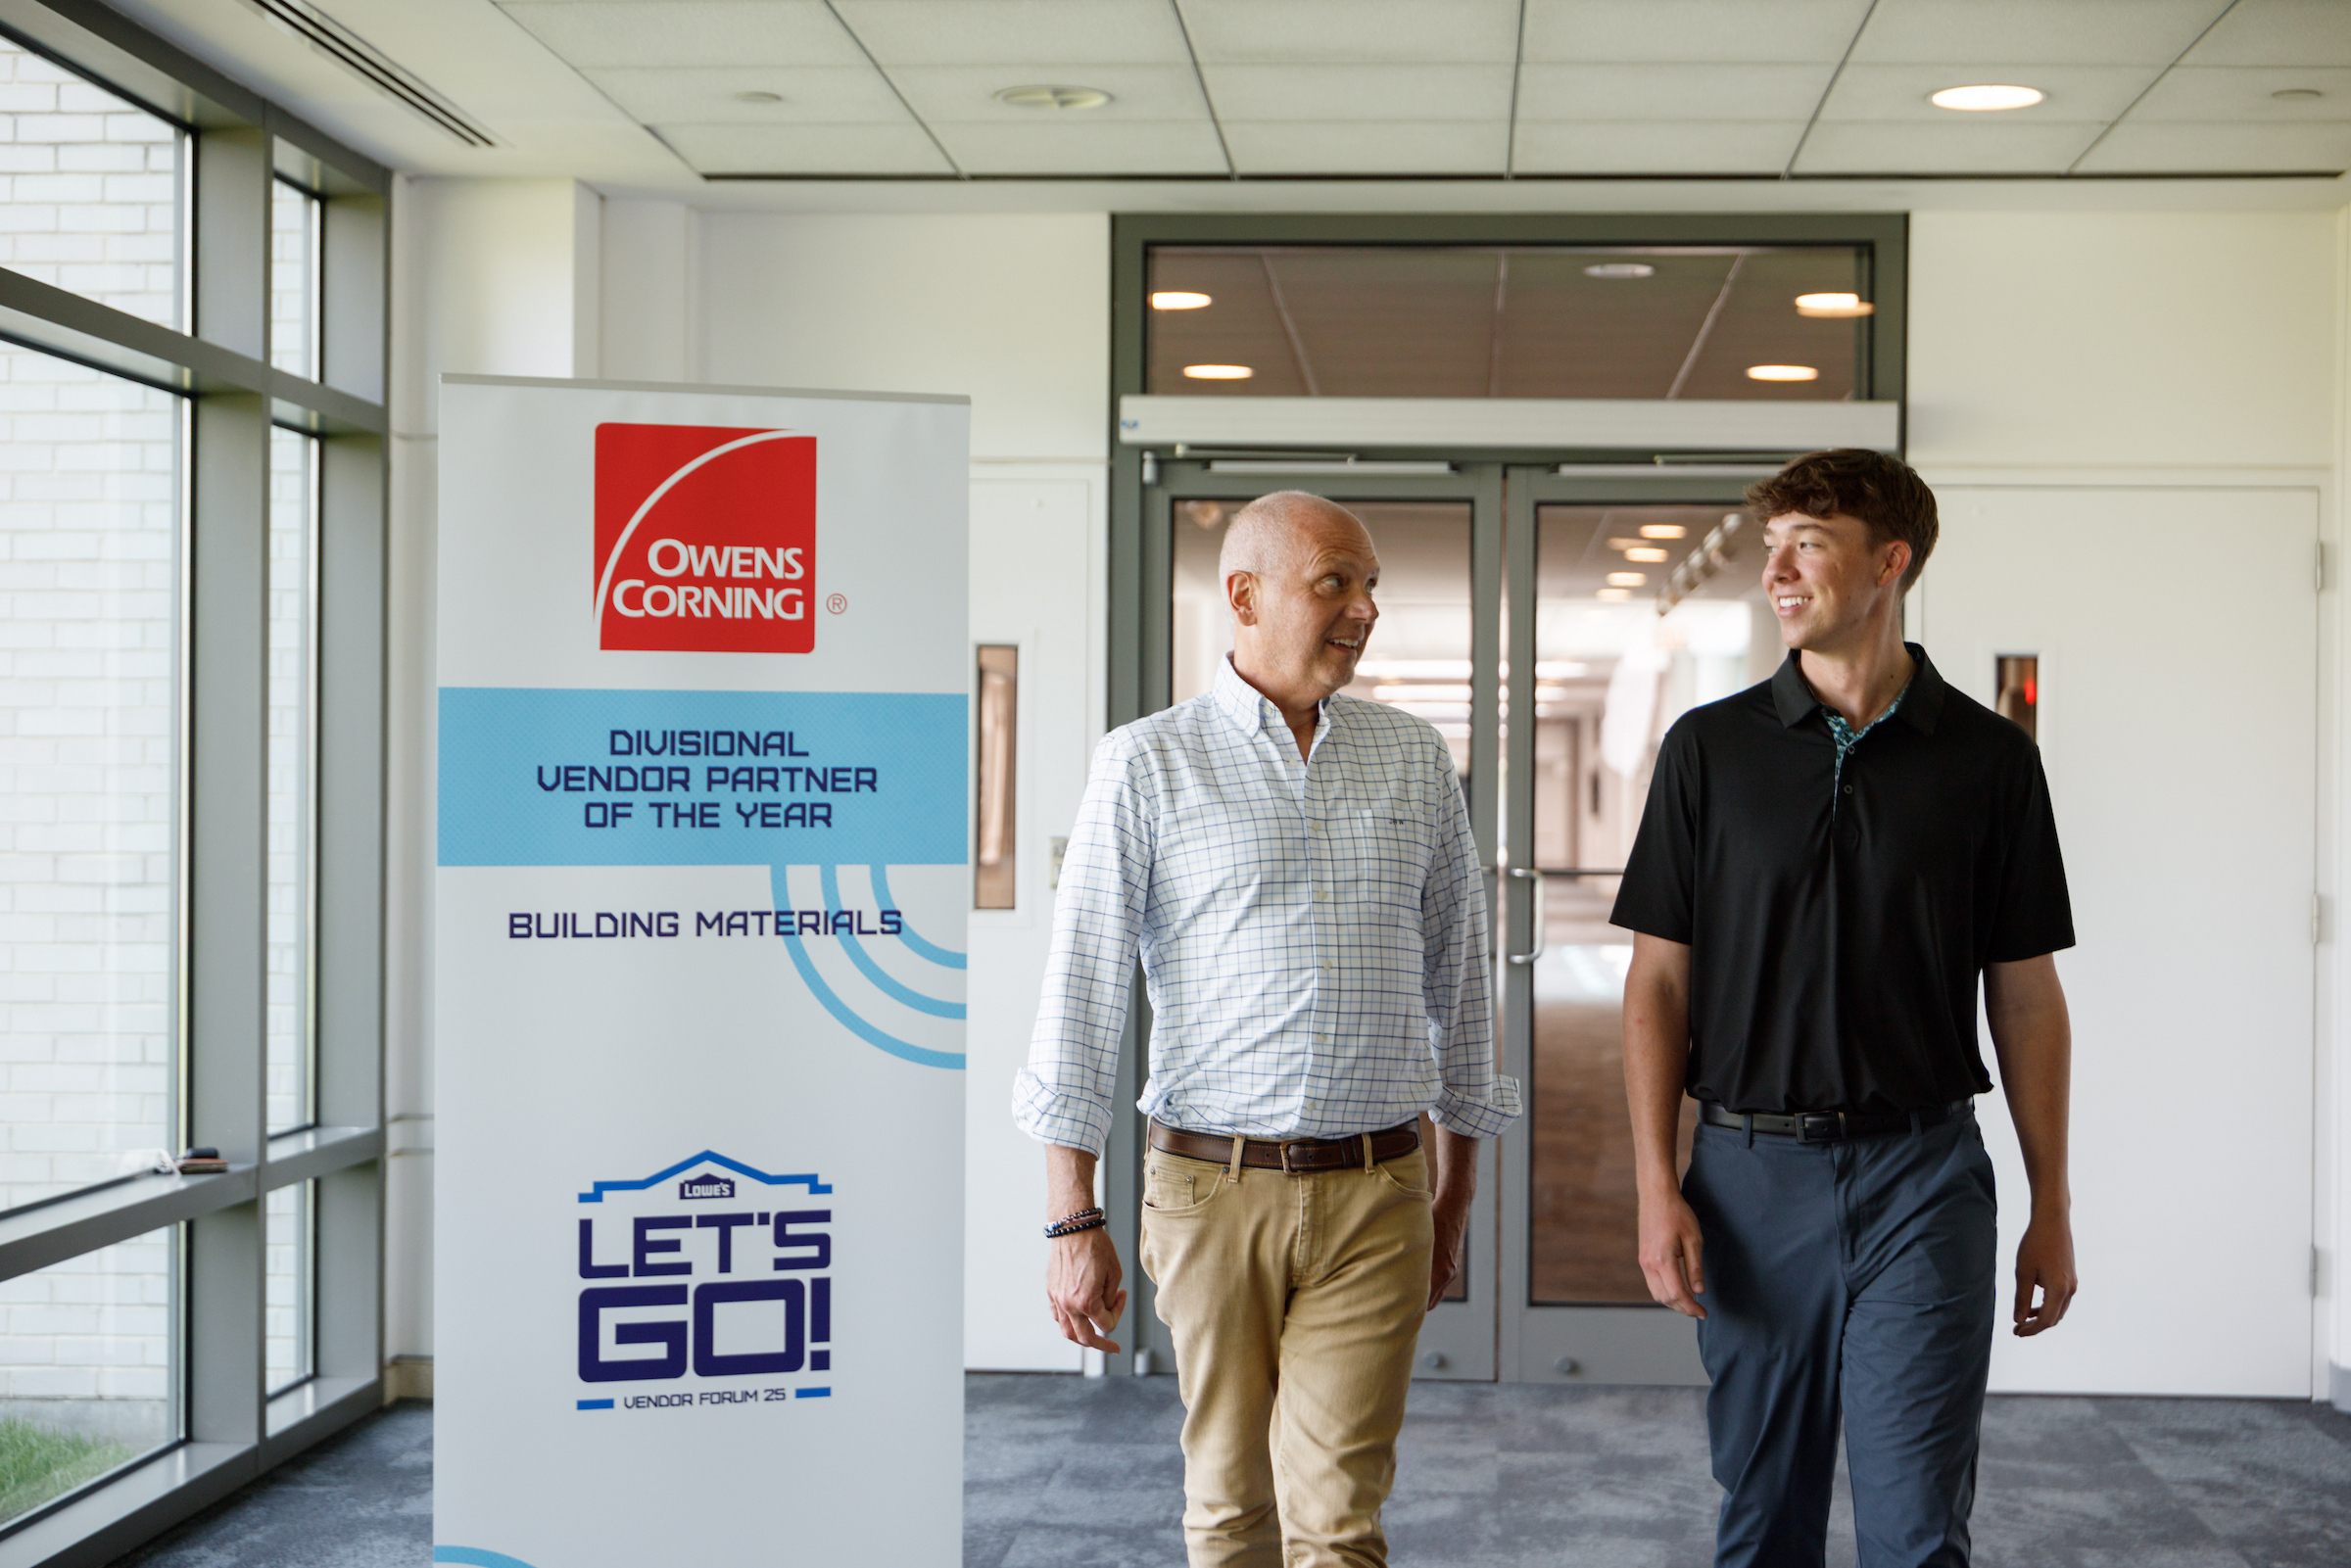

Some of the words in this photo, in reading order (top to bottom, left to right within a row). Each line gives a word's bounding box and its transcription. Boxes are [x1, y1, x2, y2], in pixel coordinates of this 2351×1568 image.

[647, 538, 804, 580] OWENS
[612, 579, 804, 621] CORNING
[609, 729, 809, 757] DIVISIONAL
[537, 765, 691, 792] VENDOR
[706, 766, 878, 792] PARTNER
[584, 801, 633, 829] OF
[648, 801, 721, 829] THE
[736, 801, 833, 829] YEAR
[508, 912, 679, 938] BUILDING
[696, 909, 902, 937] MATERIALS
[684, 1182, 732, 1198] LOWE'S
[578, 1210, 832, 1279] LET'S
[578, 1276, 832, 1383] GO!
[623, 1392, 694, 1410] VENDOR
[698, 1389, 759, 1406] FORUM
[763, 1387, 787, 1402] 25
